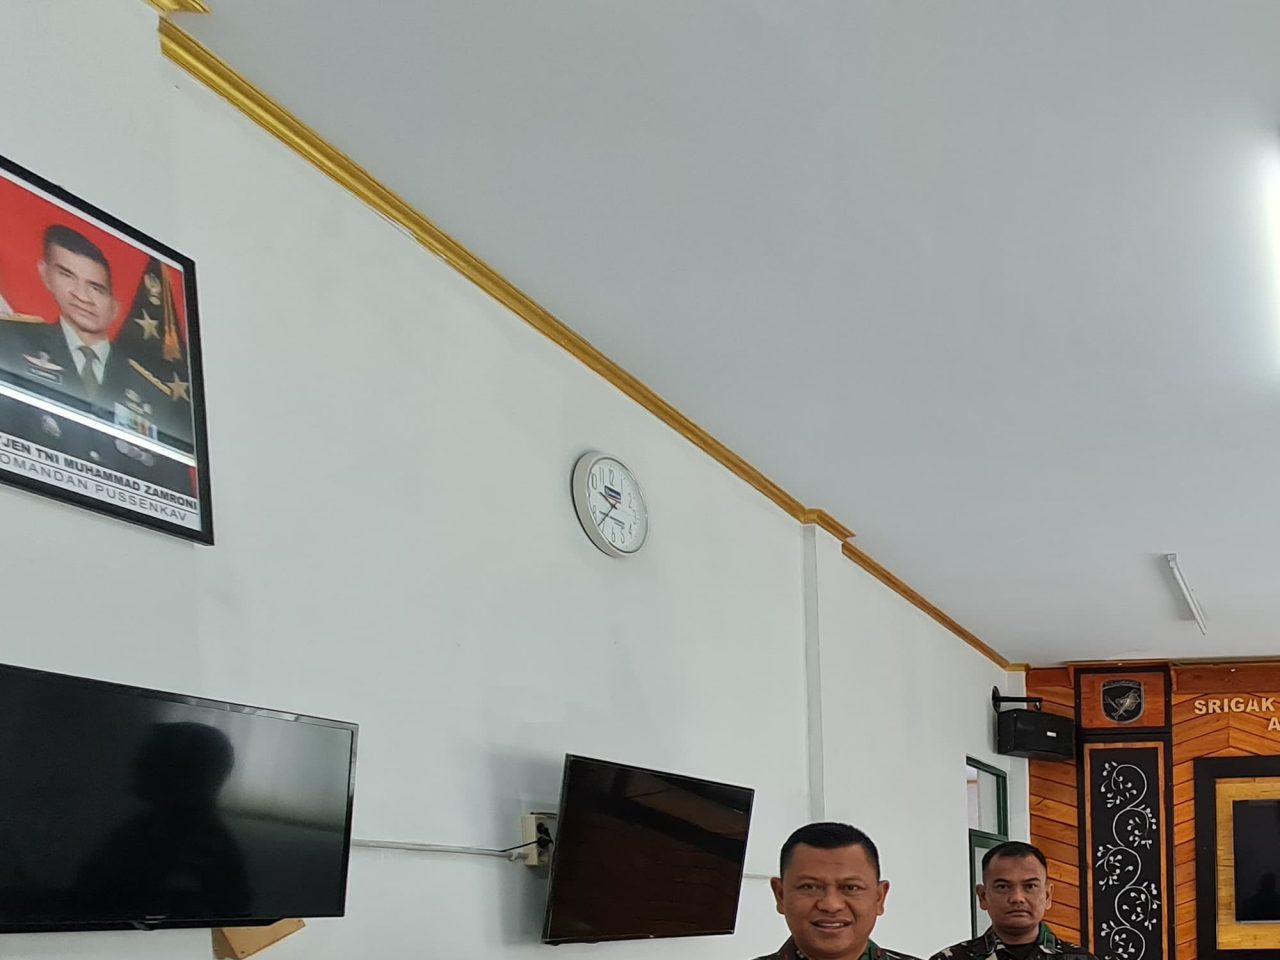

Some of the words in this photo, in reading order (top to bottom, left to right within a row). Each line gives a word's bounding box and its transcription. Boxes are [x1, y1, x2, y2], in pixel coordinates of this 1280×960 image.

[0, 436, 31, 455] JEN
[35, 447, 60, 465] TNI
[64, 456, 141, 492] MUHAMMAD
[144, 485, 197, 511] ZAMRONI
[95, 485, 187, 522] PUSSENKAV
[1193, 697, 1277, 715] SRIGAK
